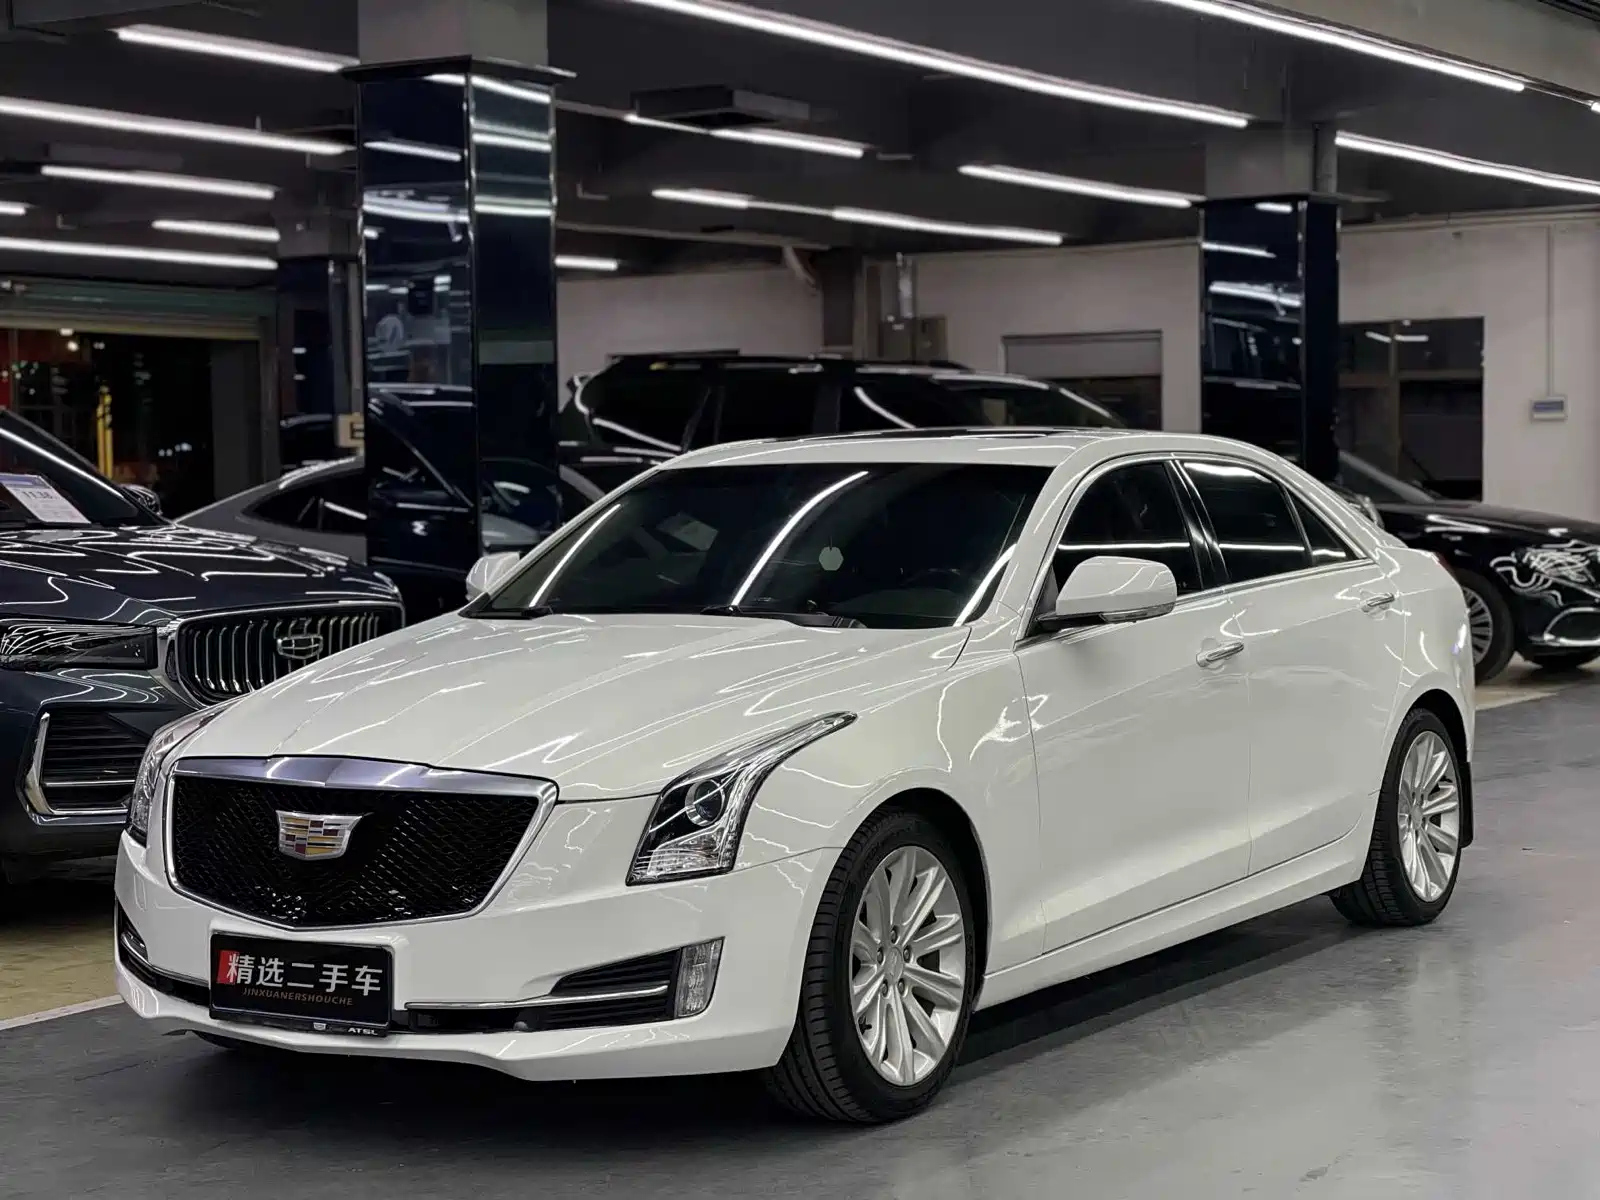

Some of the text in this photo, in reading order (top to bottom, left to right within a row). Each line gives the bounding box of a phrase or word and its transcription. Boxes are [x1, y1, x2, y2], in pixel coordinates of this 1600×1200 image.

[227, 953, 383, 996] 精选二手车
[243, 988, 354, 1006] JINXUANERSHOUCHE
